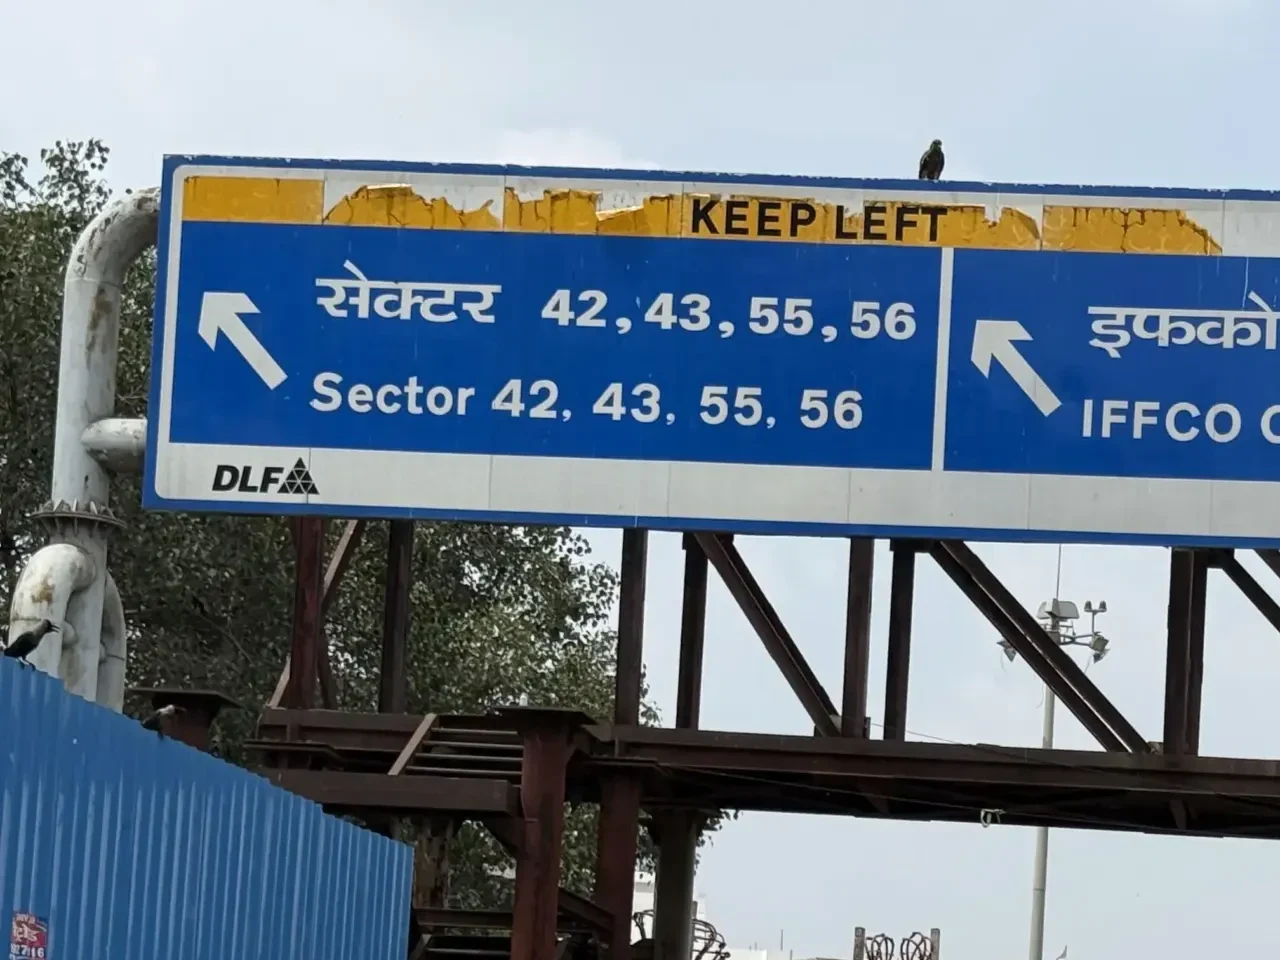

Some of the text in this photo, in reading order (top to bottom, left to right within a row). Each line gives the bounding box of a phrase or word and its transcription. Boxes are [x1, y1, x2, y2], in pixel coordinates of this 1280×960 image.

[692, 198, 948, 242] KEEP LEFT
[316, 259, 502, 323] सेक्टर
[310, 372, 863, 429] Sector 42, 43, 55, 56
[1082, 399, 1242, 443] IFFCO
[212, 464, 285, 494] DLF
